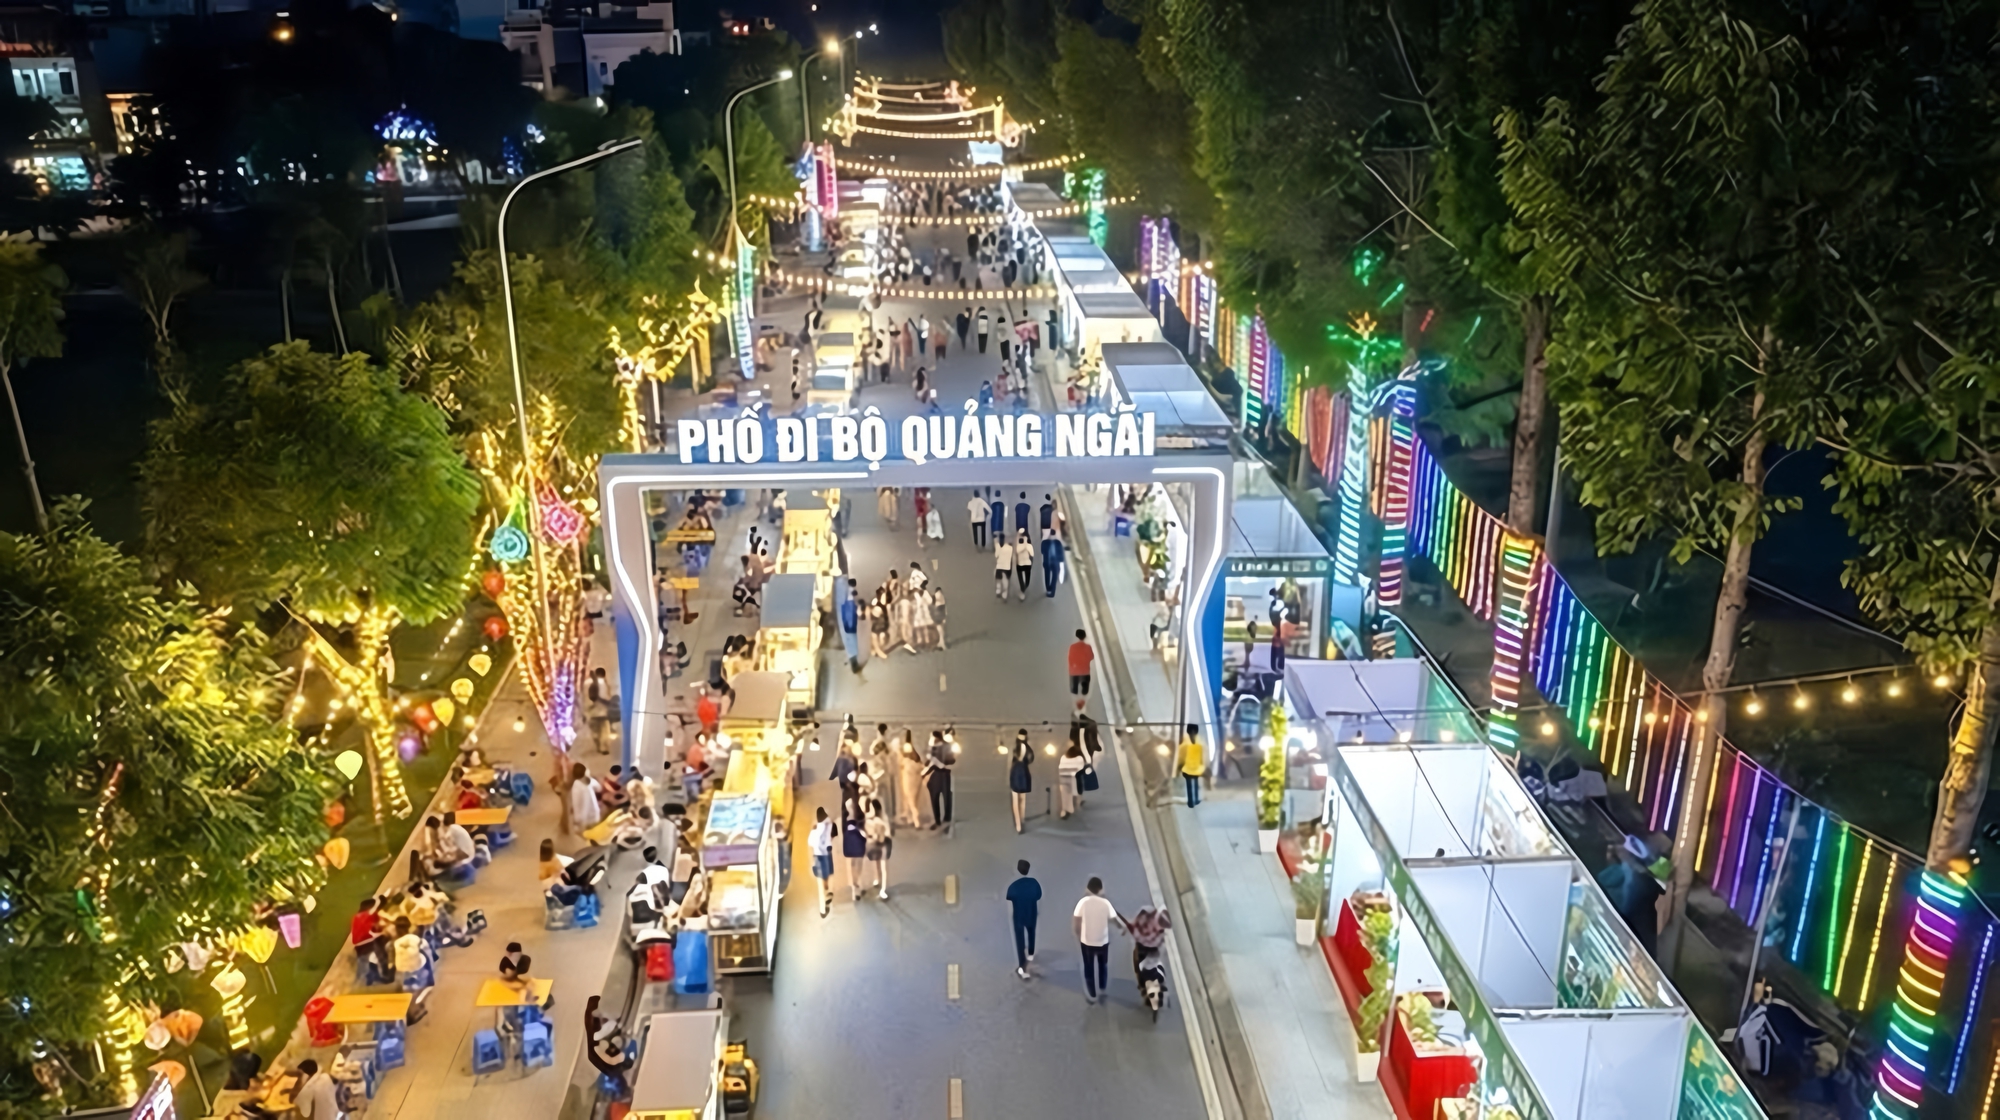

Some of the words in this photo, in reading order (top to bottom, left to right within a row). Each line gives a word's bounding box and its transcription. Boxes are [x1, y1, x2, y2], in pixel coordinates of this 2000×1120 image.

[677, 402, 763, 464] PHỐ
[775, 417, 819, 462] ĐI
[831, 406, 888, 471] BỘ
[901, 398, 1042, 466] QUẢNG
[1055, 403, 1156, 457] NGÃI
